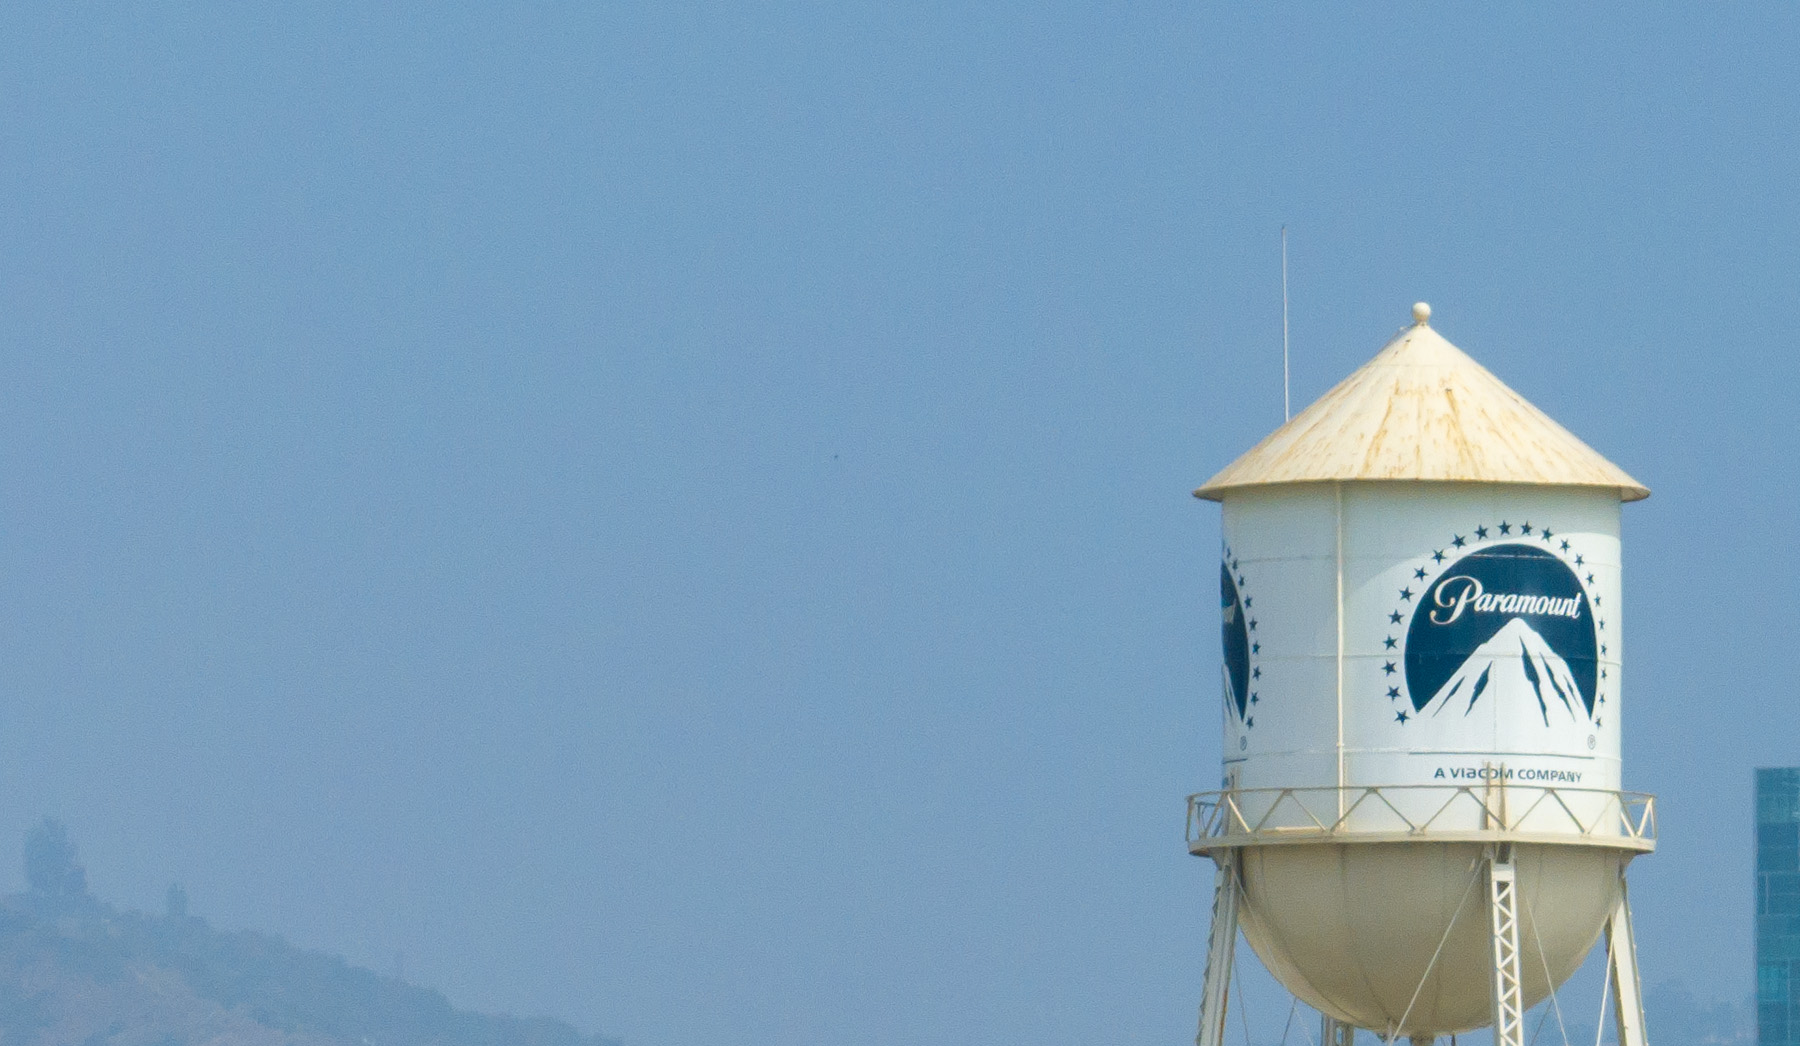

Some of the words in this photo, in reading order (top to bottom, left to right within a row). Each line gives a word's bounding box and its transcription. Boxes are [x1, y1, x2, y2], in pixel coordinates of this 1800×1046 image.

[1429, 574, 1582, 625] Paramount
[1434, 767, 1446, 779] A
[1518, 768, 1582, 783] COMPANY
